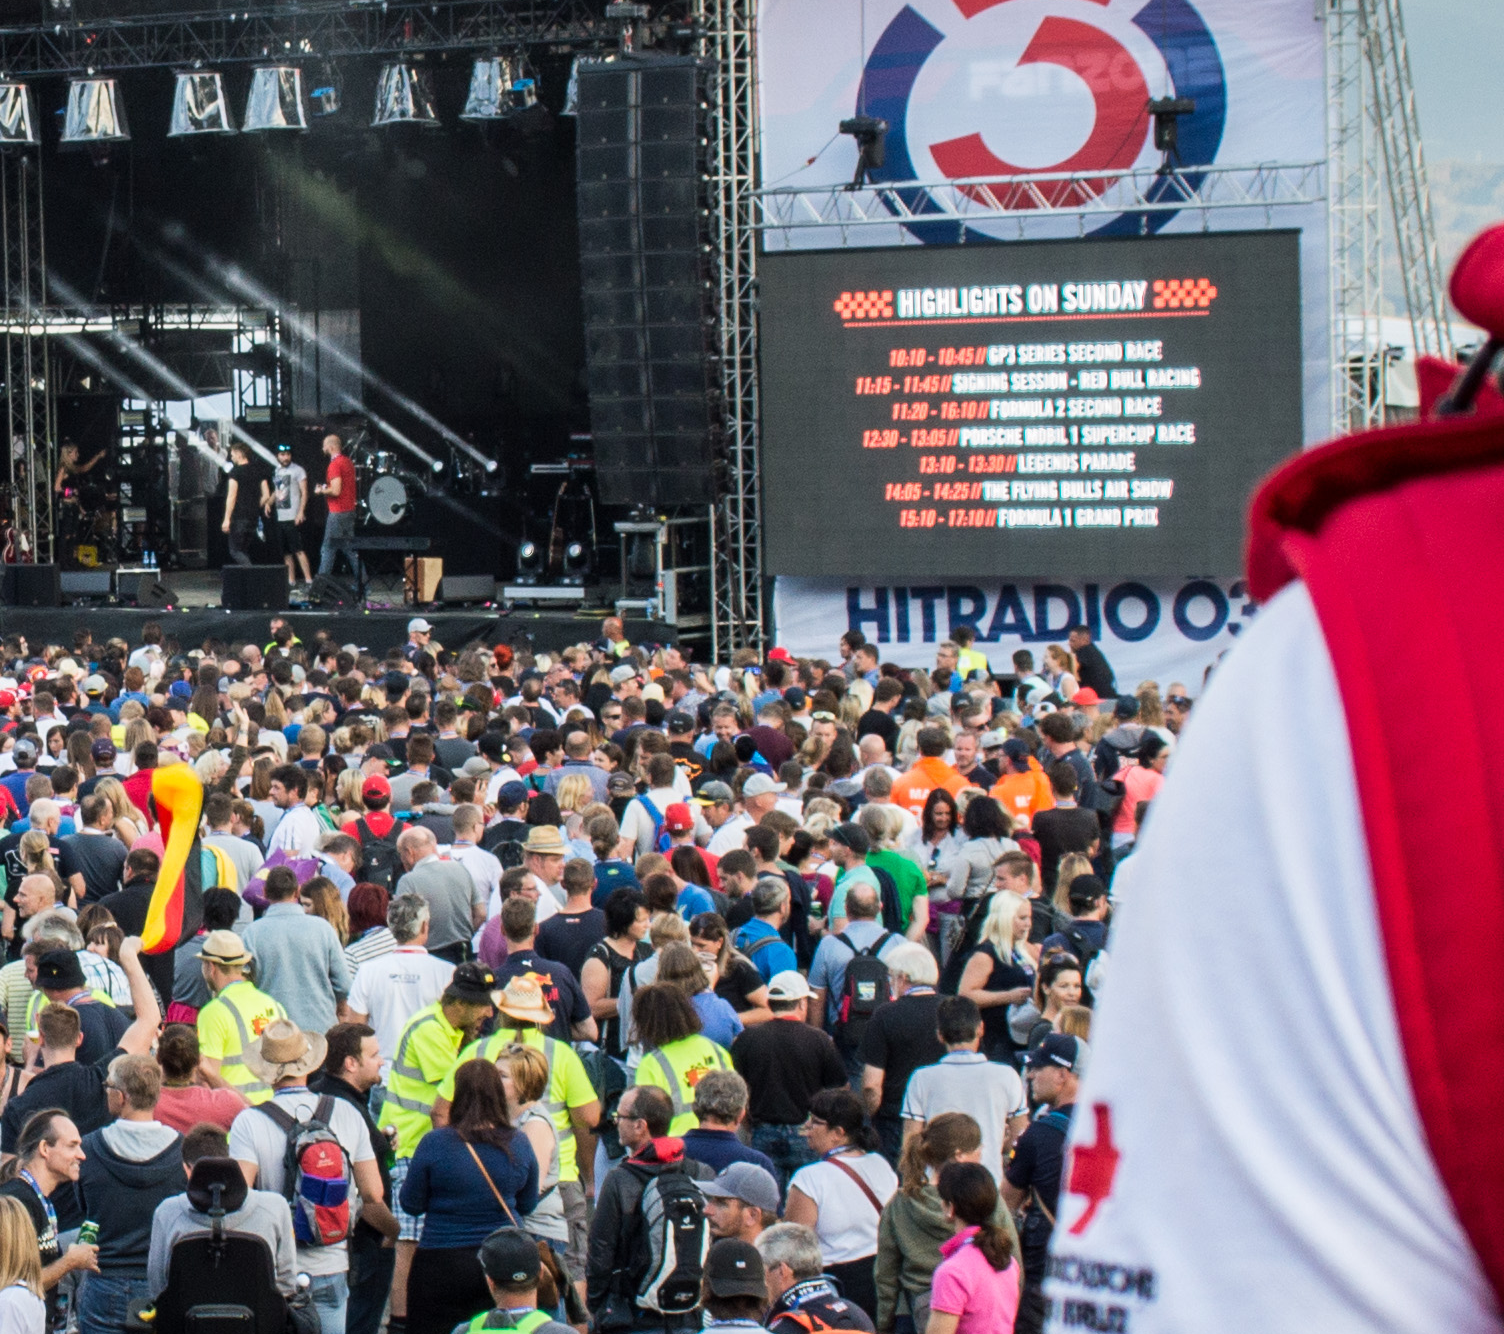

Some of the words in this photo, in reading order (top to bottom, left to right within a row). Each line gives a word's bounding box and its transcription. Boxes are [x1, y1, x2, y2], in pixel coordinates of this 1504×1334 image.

[897, 284, 1023, 318] HIGHLIGHTS
[1026, 283, 1059, 314] ON
[1062, 280, 1148, 313] SUNDAY
[889, 348, 927, 367] 10:10
[1017, 343, 1066, 365] SERIES
[1067, 341, 1123, 364] SECOND
[1124, 340, 1163, 362] RACE
[855, 376, 892, 395] 11:15
[952, 373, 1009, 394] SIGNING
[1009, 370, 1068, 392] SESSION
[1078, 369, 1108, 391] RED
[1109, 368, 1145, 390] BULL
[1145, 366, 1201, 389] RACING
[989, 399, 1054, 420] FORMULA
[1055, 397, 1066, 419] 2
[1067, 396, 1122, 418] SECOND
[1123, 395, 1162, 417] RACE
[959, 426, 1024, 448] PORSCHE
[1069, 425, 1079, 446] 1
[1082, 423, 1155, 446] SUPERCUP
[1156, 422, 1196, 445] RACE
[1017, 452, 1079, 474] LEGENDS
[1080, 452, 1136, 473] PARADE
[983, 480, 1010, 501] THE
[1010, 480, 1058, 501] FLYING
[1059, 479, 1102, 501] BULLS
[1103, 479, 1130, 500] AIR
[1130, 478, 1174, 500] SHOW
[997, 507, 1062, 528] FORMULA
[1063, 507, 1072, 528] 1
[1074, 506, 1121, 528] GRAND
[1122, 505, 1159, 527] PRIX
[846, 581, 1161, 643] HITRADIO
